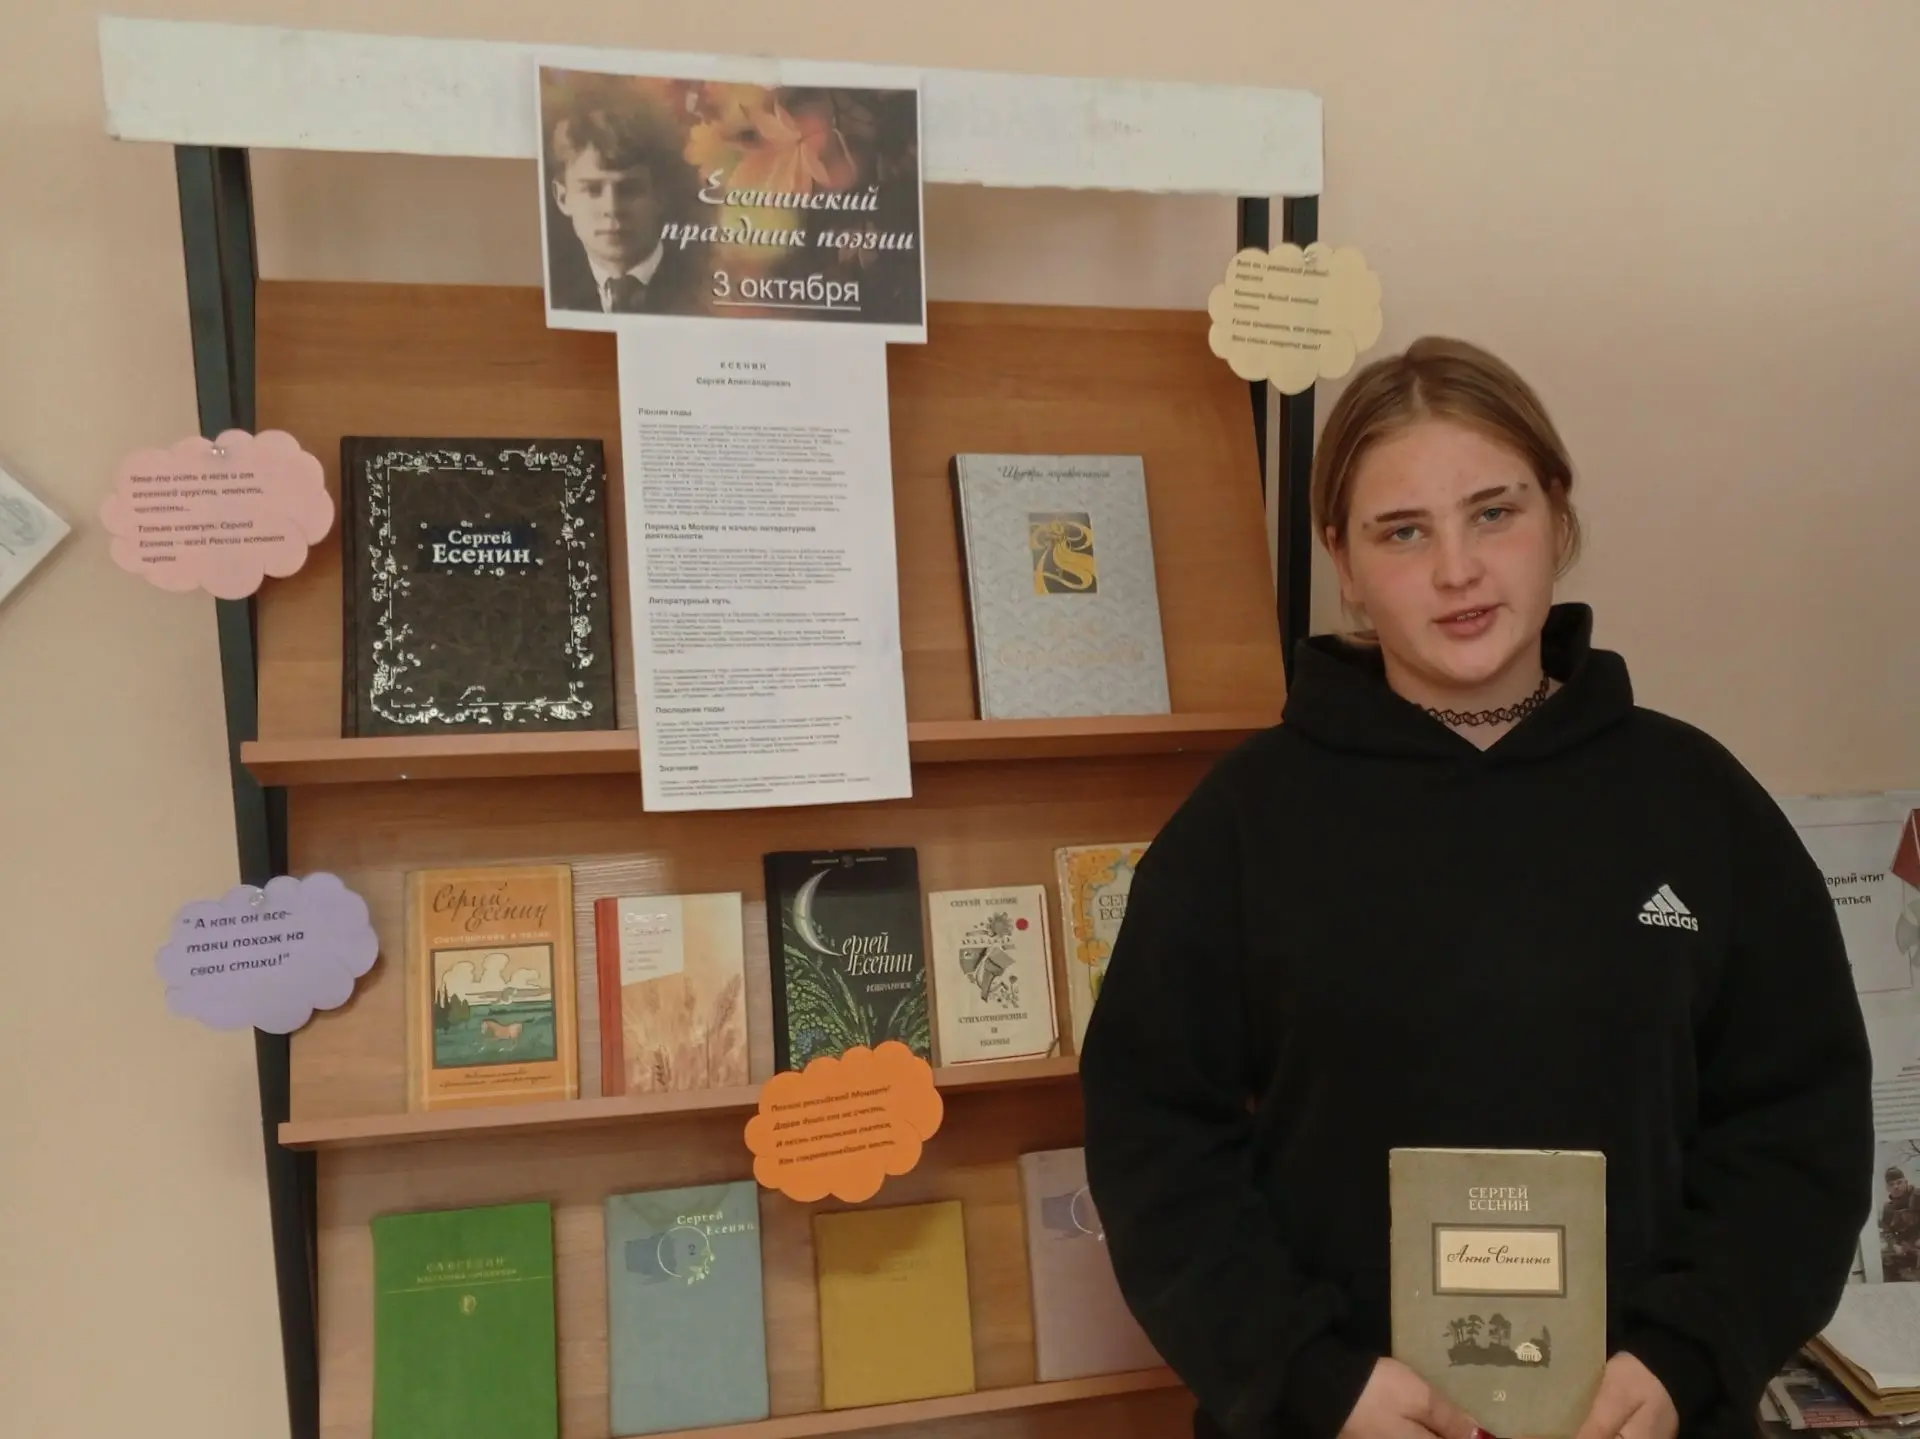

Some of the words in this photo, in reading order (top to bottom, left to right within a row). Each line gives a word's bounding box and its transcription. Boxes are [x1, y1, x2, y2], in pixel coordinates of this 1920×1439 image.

[698, 168, 880, 212] Есенинский
[660, 216, 805, 250] праздник
[816, 229, 914, 251] поэзии
[712, 271, 730, 297] 3
[740, 274, 860, 307] октября
[448, 529, 512, 548] Сергей
[432, 543, 531, 564] Есенин
[1823, 871, 1858, 888] орый
[1860, 872, 1885, 884] чтит
[194, 917, 206, 929] А
[210, 915, 237, 927] как
[240, 912, 259, 924] он
[263, 909, 293, 921] все-
[465, 903, 548, 932] Есенин
[1638, 910, 1699, 932] adidas
[186, 940, 228, 953] таки
[232, 934, 282, 949] похож
[286, 930, 305, 942] на
[190, 962, 225, 977] свои
[1468, 1185, 1528, 1199] СЕРГЕЙ
[1469, 1199, 1530, 1211] ЕСЕНИН
[677, 1211, 724, 1226] Сергей
[1447, 1244, 1490, 1264] Анна
[1487, 1245, 1551, 1265] Снегина
